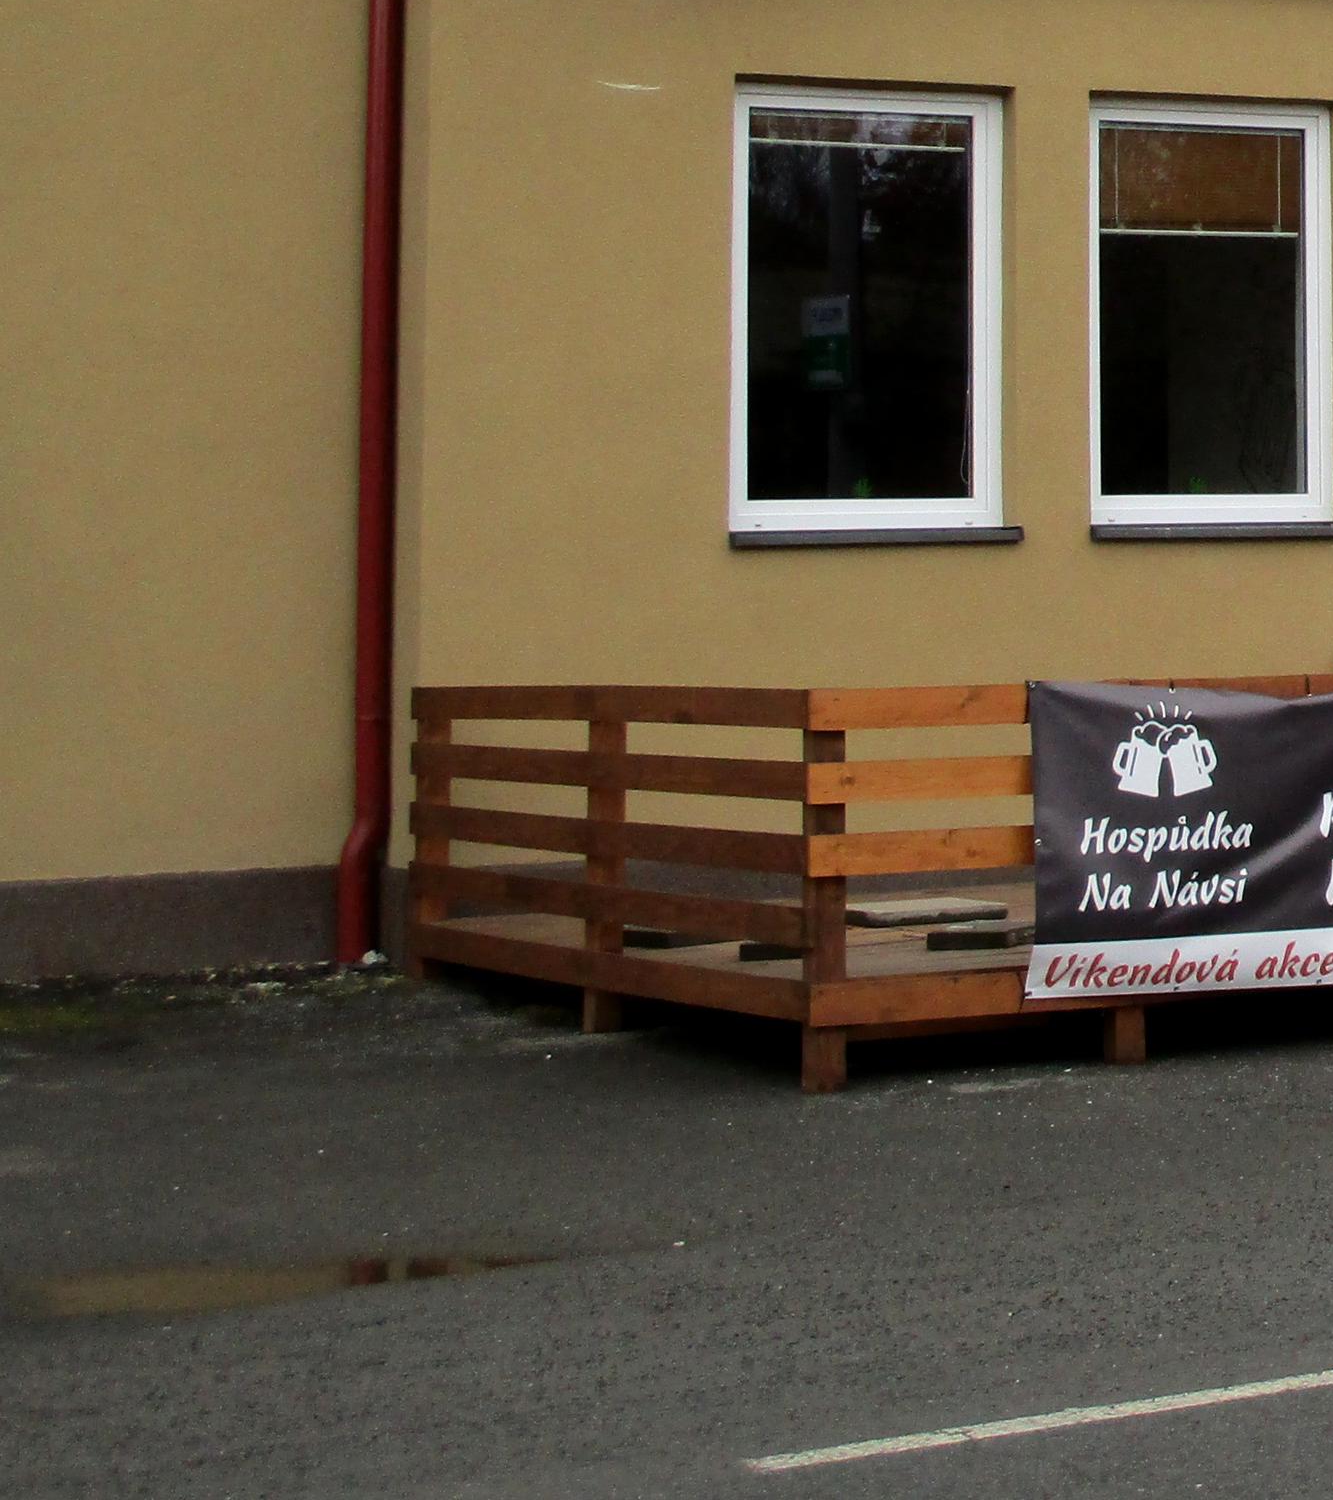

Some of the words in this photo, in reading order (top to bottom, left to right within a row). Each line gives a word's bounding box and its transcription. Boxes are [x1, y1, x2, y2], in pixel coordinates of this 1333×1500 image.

[1080, 810, 1253, 863] Hospůdka
[1078, 872, 1132, 912] Na
[1148, 867, 1248, 909] Návsi
